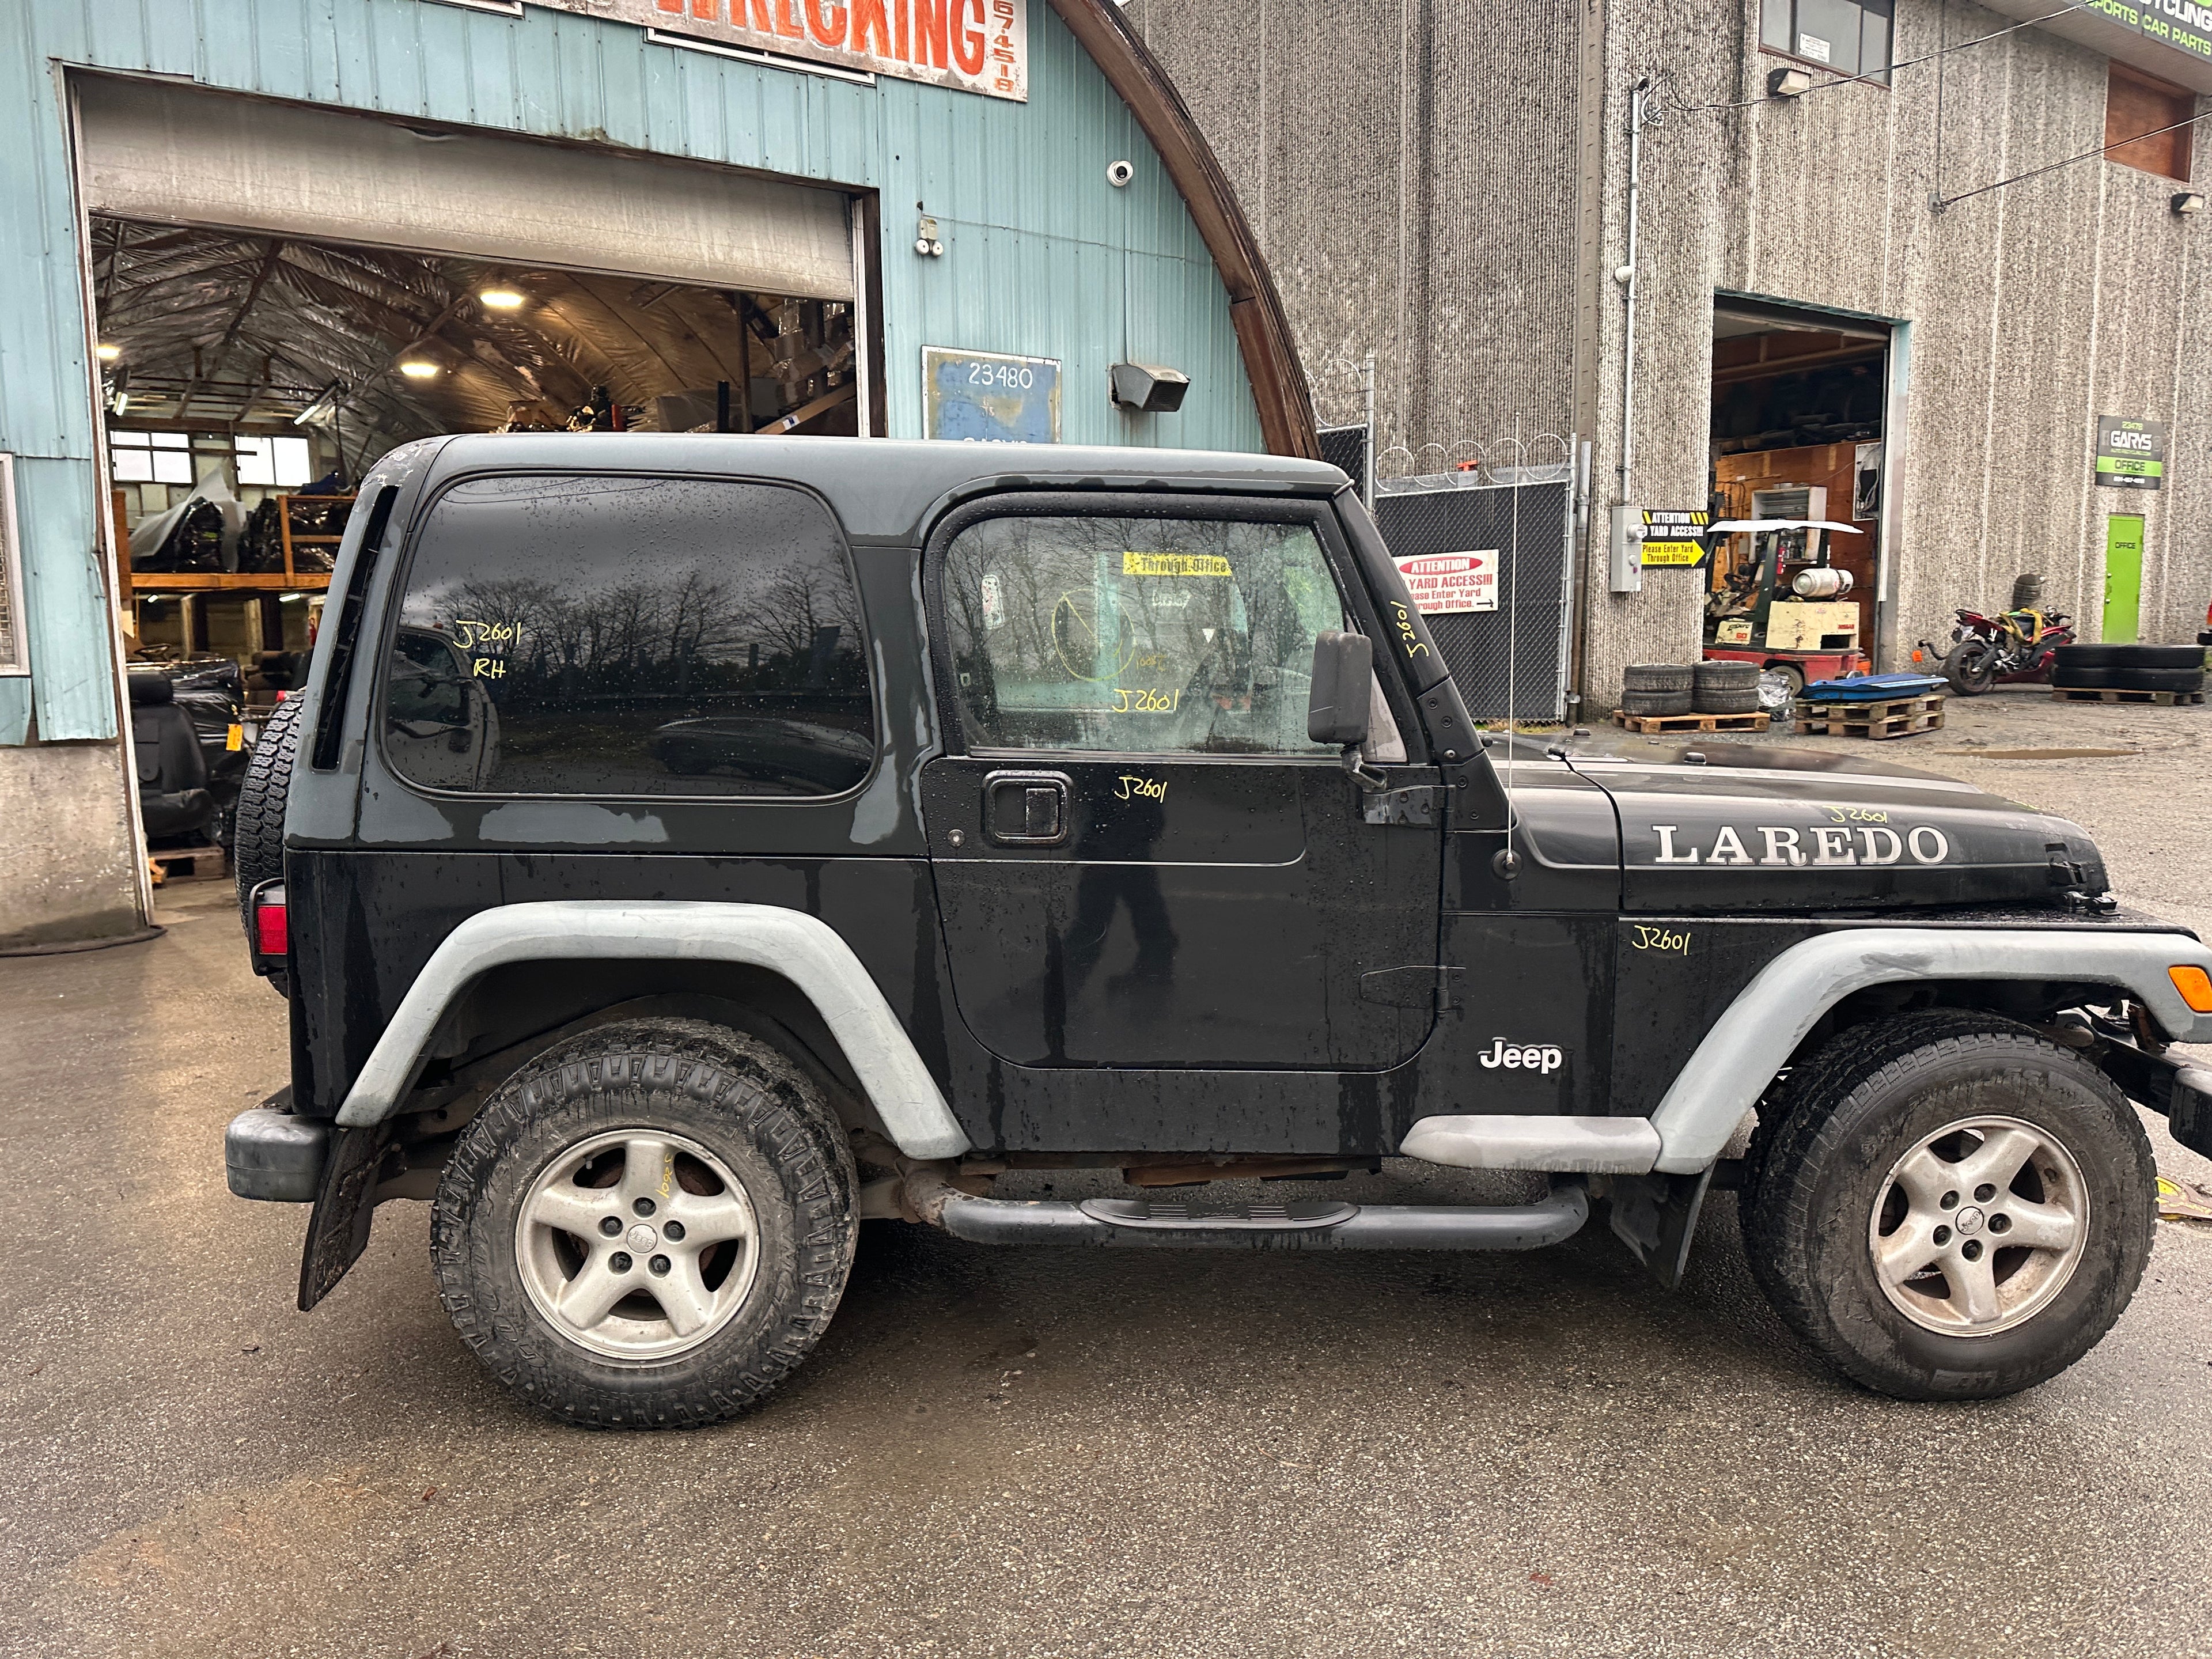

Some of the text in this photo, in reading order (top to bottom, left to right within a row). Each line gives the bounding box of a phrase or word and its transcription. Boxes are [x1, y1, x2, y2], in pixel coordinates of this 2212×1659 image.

[2139, 0, 2212, 32] CLING
[657, 0, 986, 75] CKING
[2142, 14, 2169, 38] CAR
[2172, 27, 2211, 55] PARTS
[968, 362, 1033, 389] 23480
[2111, 430, 2152, 450] GARYS
[2115, 460, 2145, 471] OFFICE
[1652, 512, 1690, 524] ATTENTION
[1650, 525, 1668, 536] YARD
[1671, 525, 1703, 536] ACCESS!!!
[1642, 544, 1694, 553] Please Enter Yard
[1647, 554, 1689, 563] Through Office
[1141, 557, 1227, 574] Through Office
[1411, 558, 1470, 573] ATTENTION
[1409, 574, 1493, 590] YARD ACCESS!!!
[1431, 590, 1456, 599] Enter
[1459, 588, 1481, 597] Yard
[1416, 600, 1443, 611] rough
[453, 619, 521, 649] J2601
[1390, 601, 1429, 658] J2601
[474, 658, 506, 679] RH
[1112, 688, 1179, 713] J2601
[1114, 776, 1168, 803] J2601
[1822, 805, 1888, 823] J2601
[1652, 825, 1949, 866] LAREDO
[1631, 925, 1691, 956] J2601
[1479, 1039, 1562, 1074] Jeep
[1961, 1211, 1981, 1232] Jeep
[630, 1230, 654, 1248] Jeep
